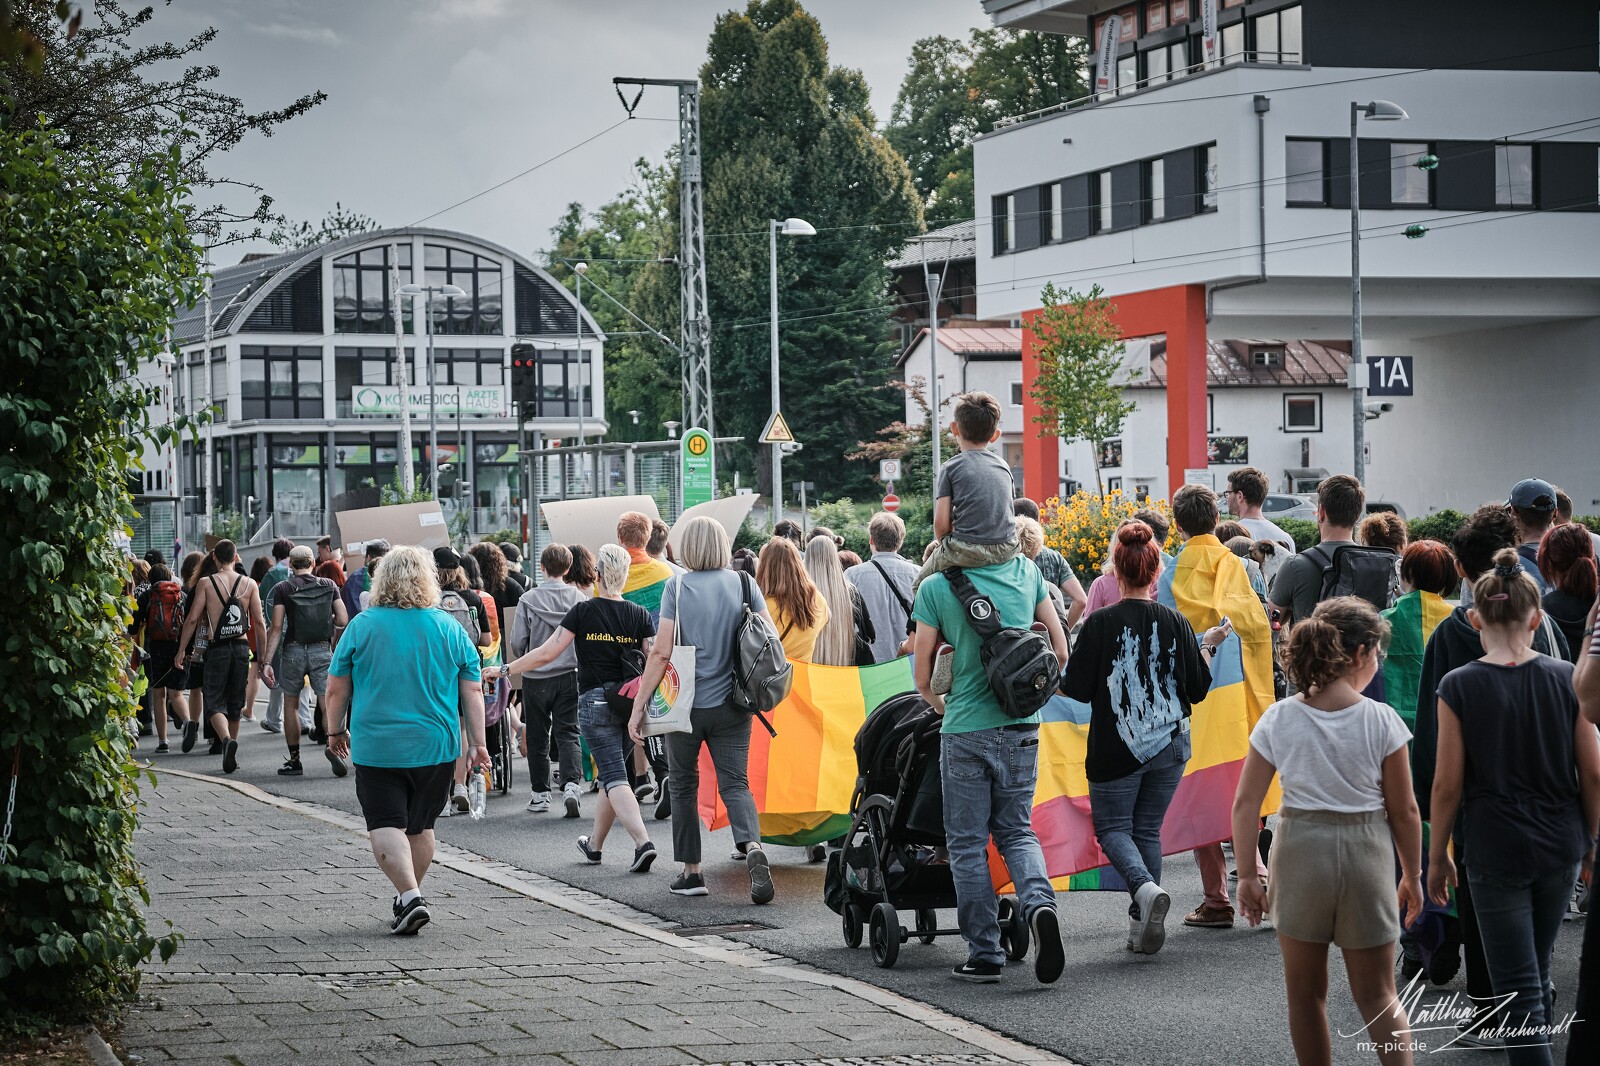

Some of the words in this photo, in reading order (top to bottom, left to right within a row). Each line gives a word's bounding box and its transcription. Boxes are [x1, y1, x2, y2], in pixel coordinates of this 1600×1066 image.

[1374, 357, 1409, 387] 1A
[467, 389, 499, 399] ÄRZTE
[466, 399, 499, 409] HAUS
[693, 438, 702, 451] H
